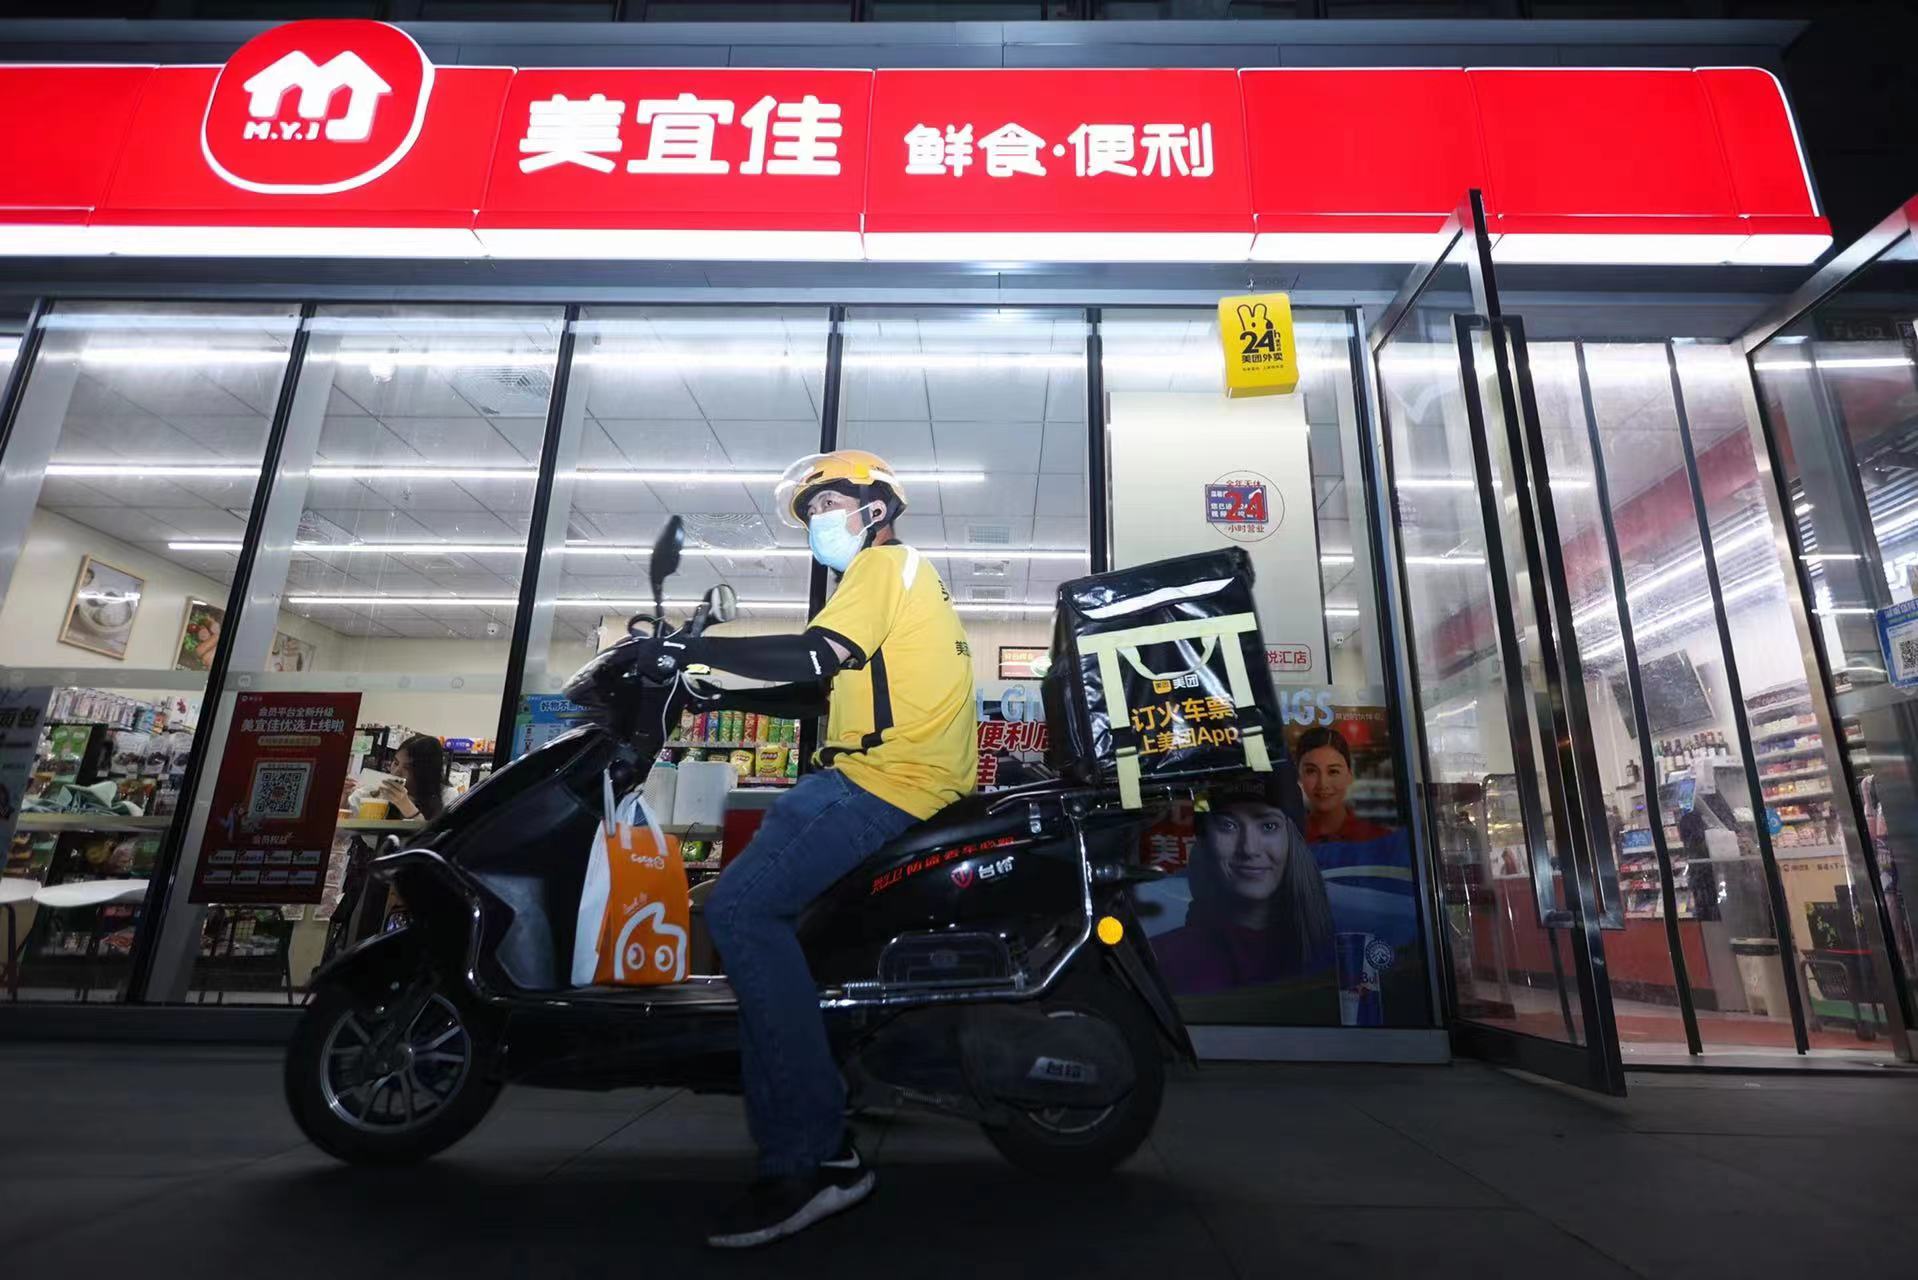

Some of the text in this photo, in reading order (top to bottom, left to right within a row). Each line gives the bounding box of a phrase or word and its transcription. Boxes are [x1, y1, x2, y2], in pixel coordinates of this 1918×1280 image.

[518, 93, 843, 175] 美宜佳
[904, 122, 1214, 177] 鲜食·便利
[1242, 352, 1283, 364] 美团外卖
[1225, 492, 1265, 522] 24
[1228, 524, 1264, 533] 小时营业
[1172, 673, 1199, 690] 美团
[258, 706, 334, 717] 会员平台全新升级
[1131, 696, 1235, 733] 订火车票
[241, 718, 345, 733] 美宜佳优选上线啦
[1139, 726, 1239, 756] 上美团App
